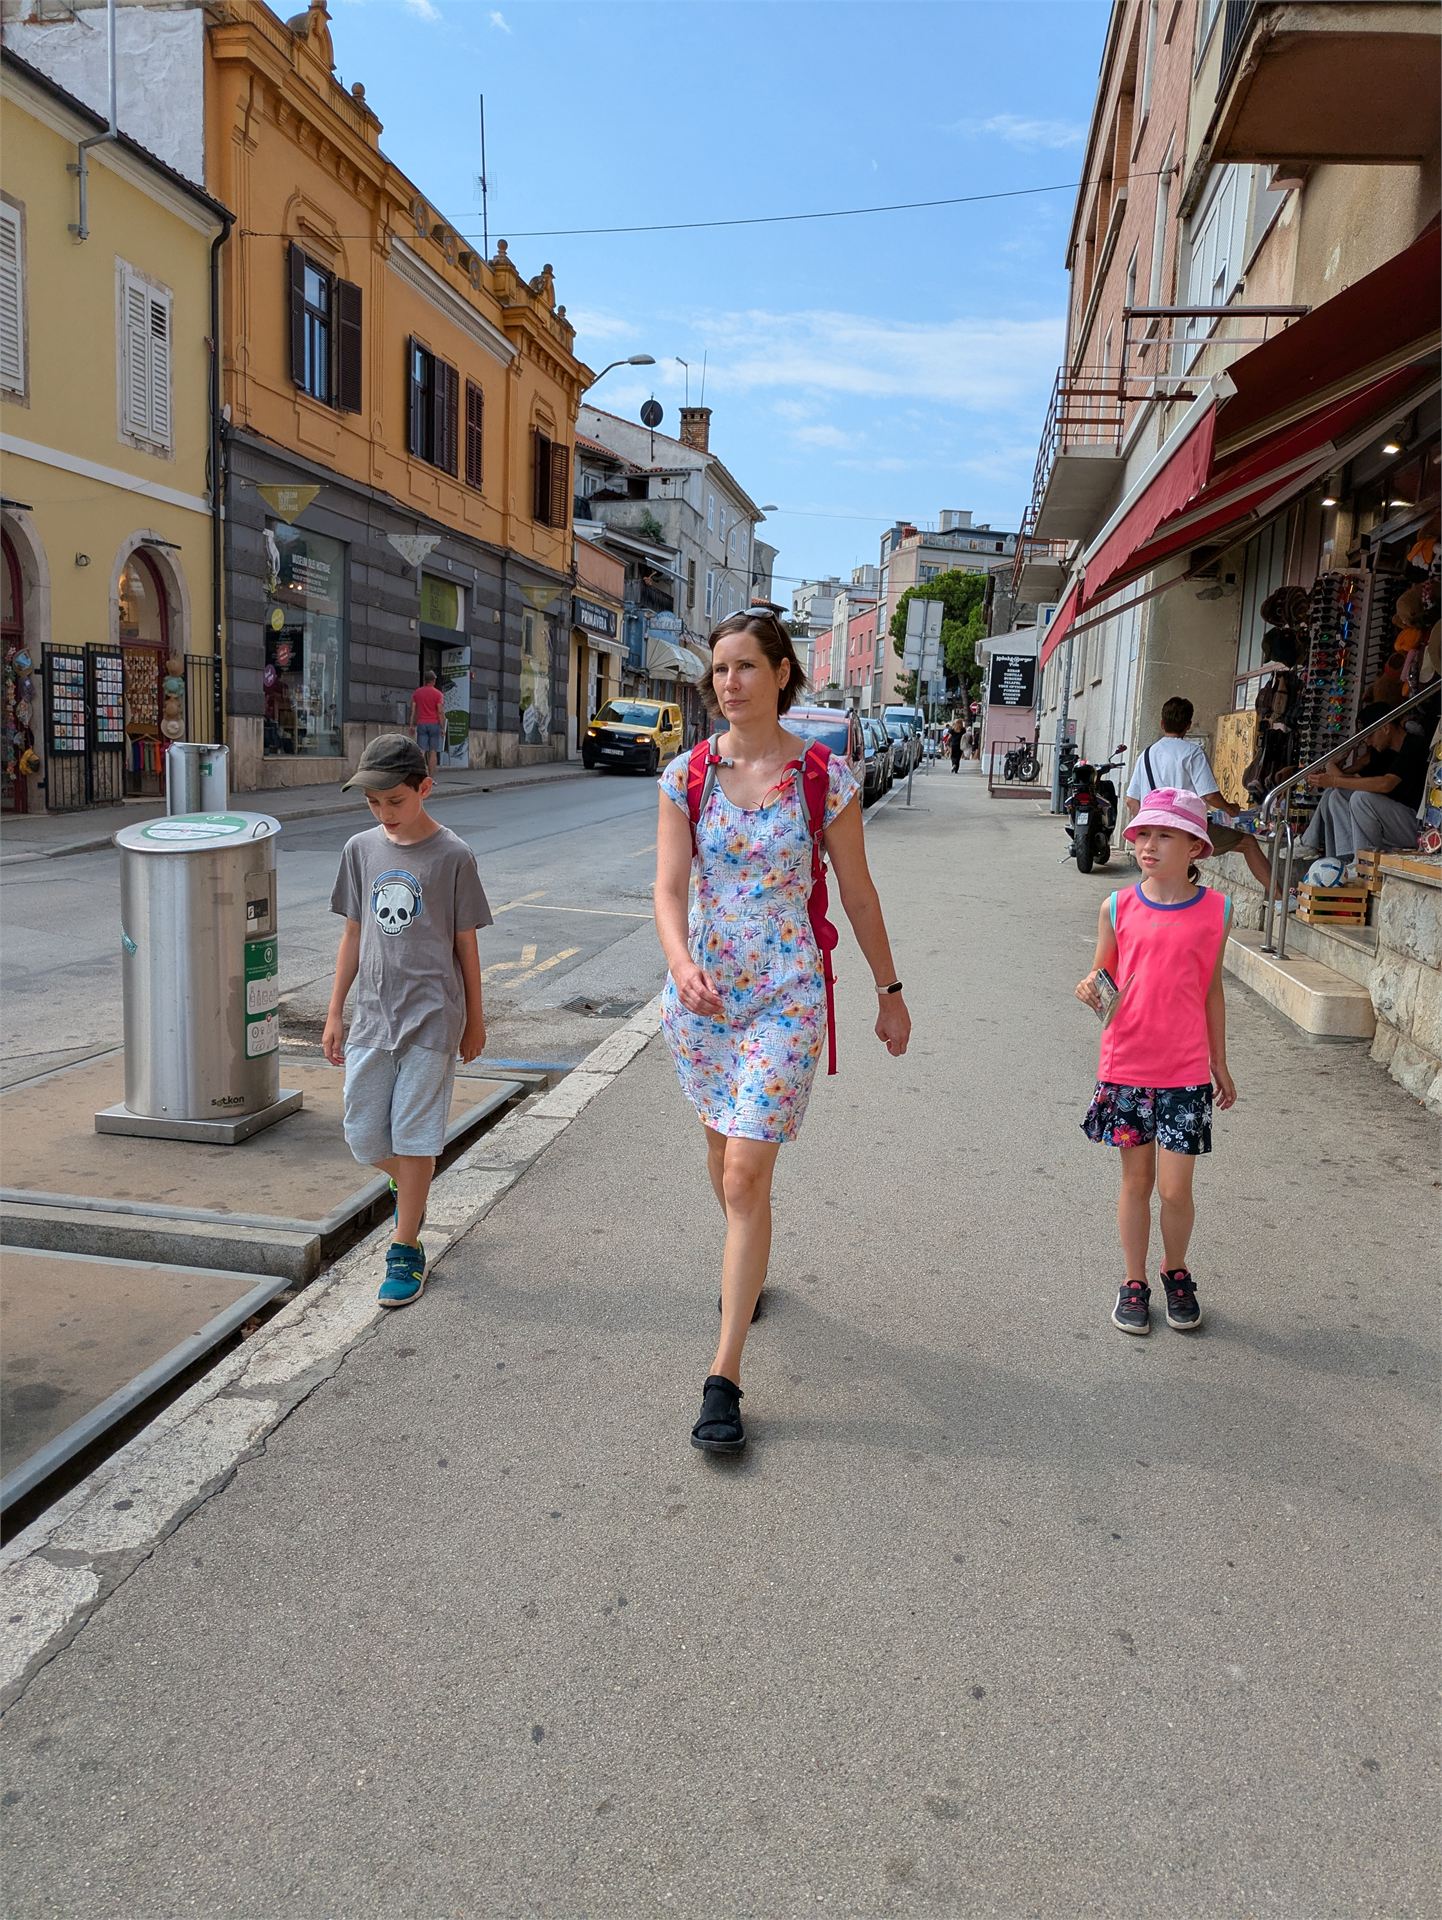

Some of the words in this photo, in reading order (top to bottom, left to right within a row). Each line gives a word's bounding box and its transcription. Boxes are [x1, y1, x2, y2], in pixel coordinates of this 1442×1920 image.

[292, 554, 307, 566] MUSEUM
[581, 609, 607, 631] PRIMAVERA
[211, 1096, 245, 1107] sotkon
